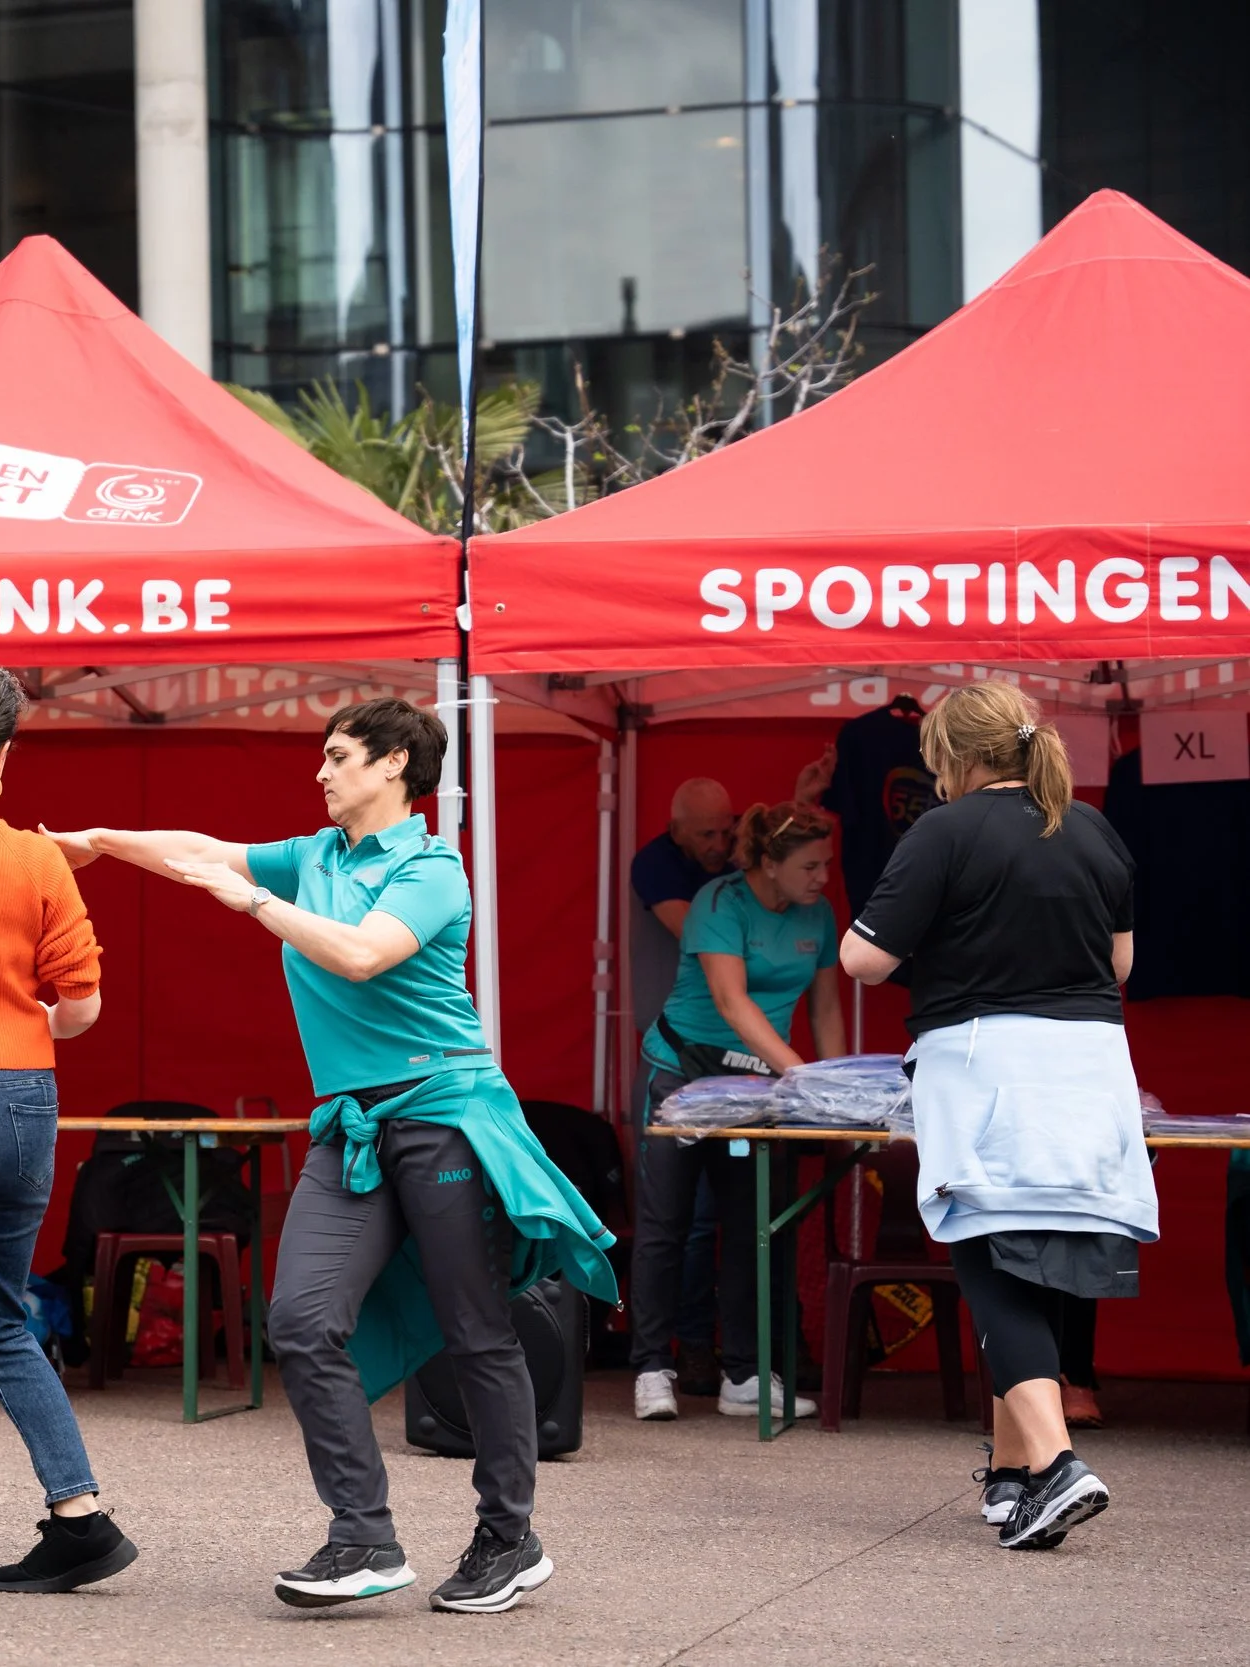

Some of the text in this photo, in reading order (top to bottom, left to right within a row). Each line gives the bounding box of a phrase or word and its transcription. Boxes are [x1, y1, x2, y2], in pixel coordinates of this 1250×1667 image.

[86, 508, 164, 522] GENK
[1174, 731, 1215, 760] XL
[437, 1168, 472, 1184] JAKO
